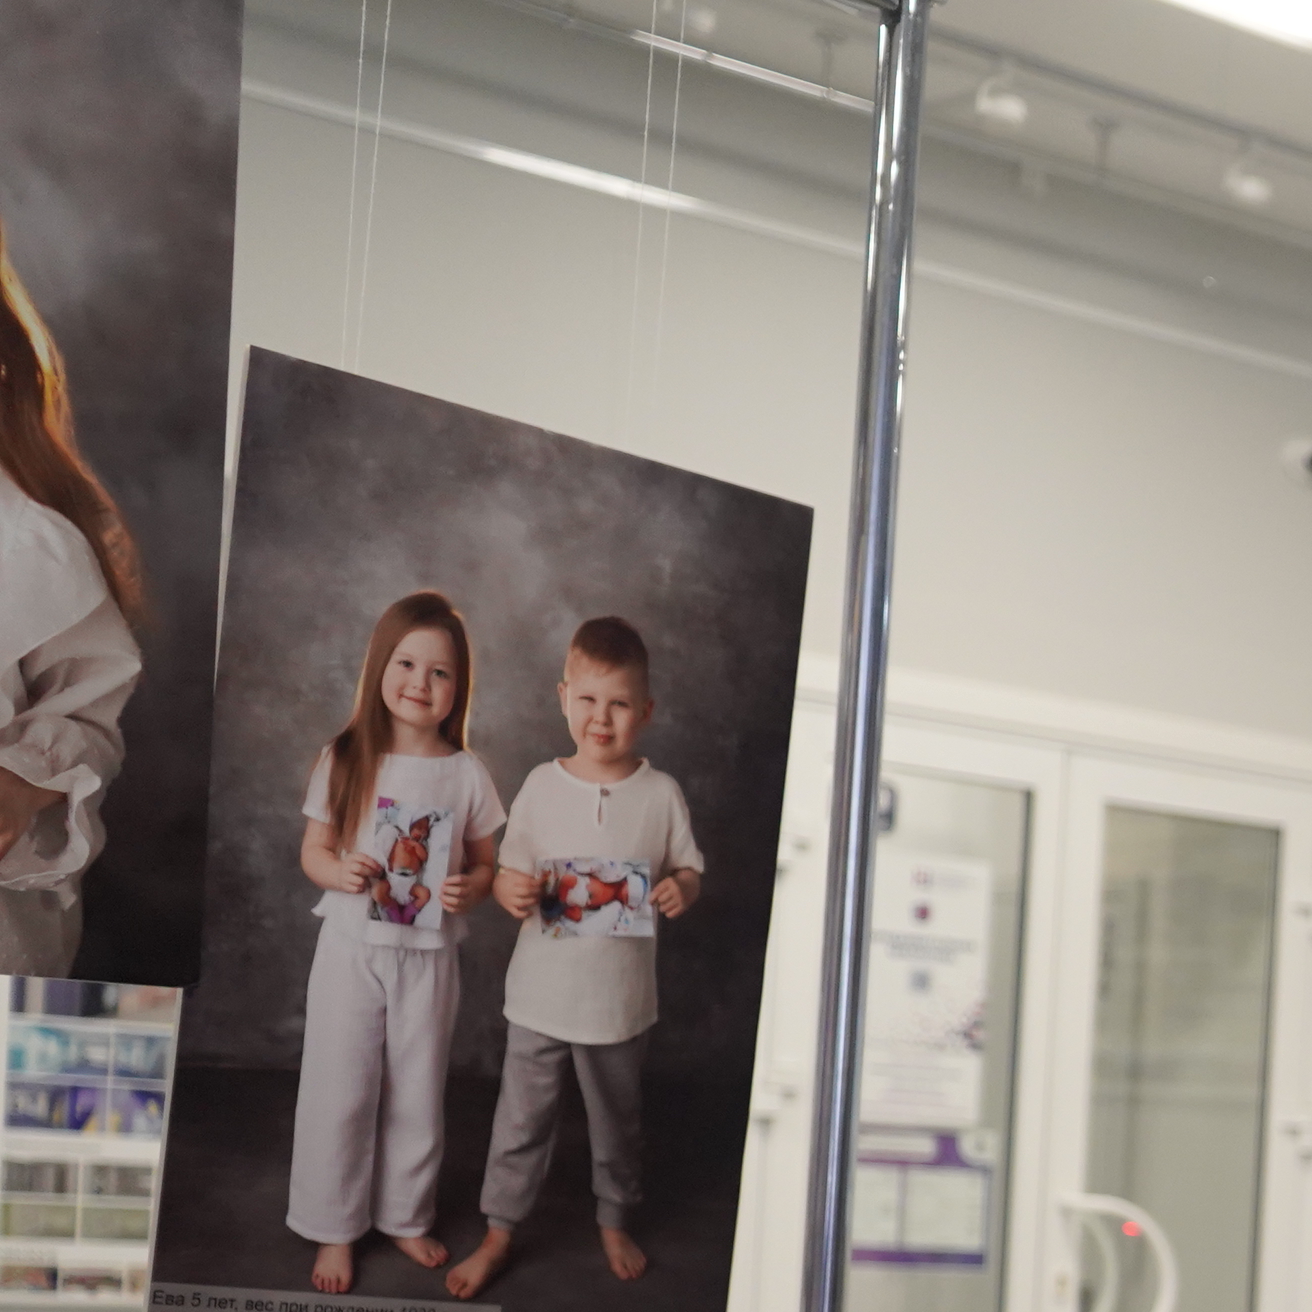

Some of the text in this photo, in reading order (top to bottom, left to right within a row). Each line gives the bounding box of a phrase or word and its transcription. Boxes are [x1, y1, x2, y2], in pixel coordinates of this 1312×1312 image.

[152, 1289, 185, 1307] Ева
[190, 1291, 202, 1308] 5
[206, 1296, 239, 1312] лет,
[245, 1299, 274, 1312] вес
